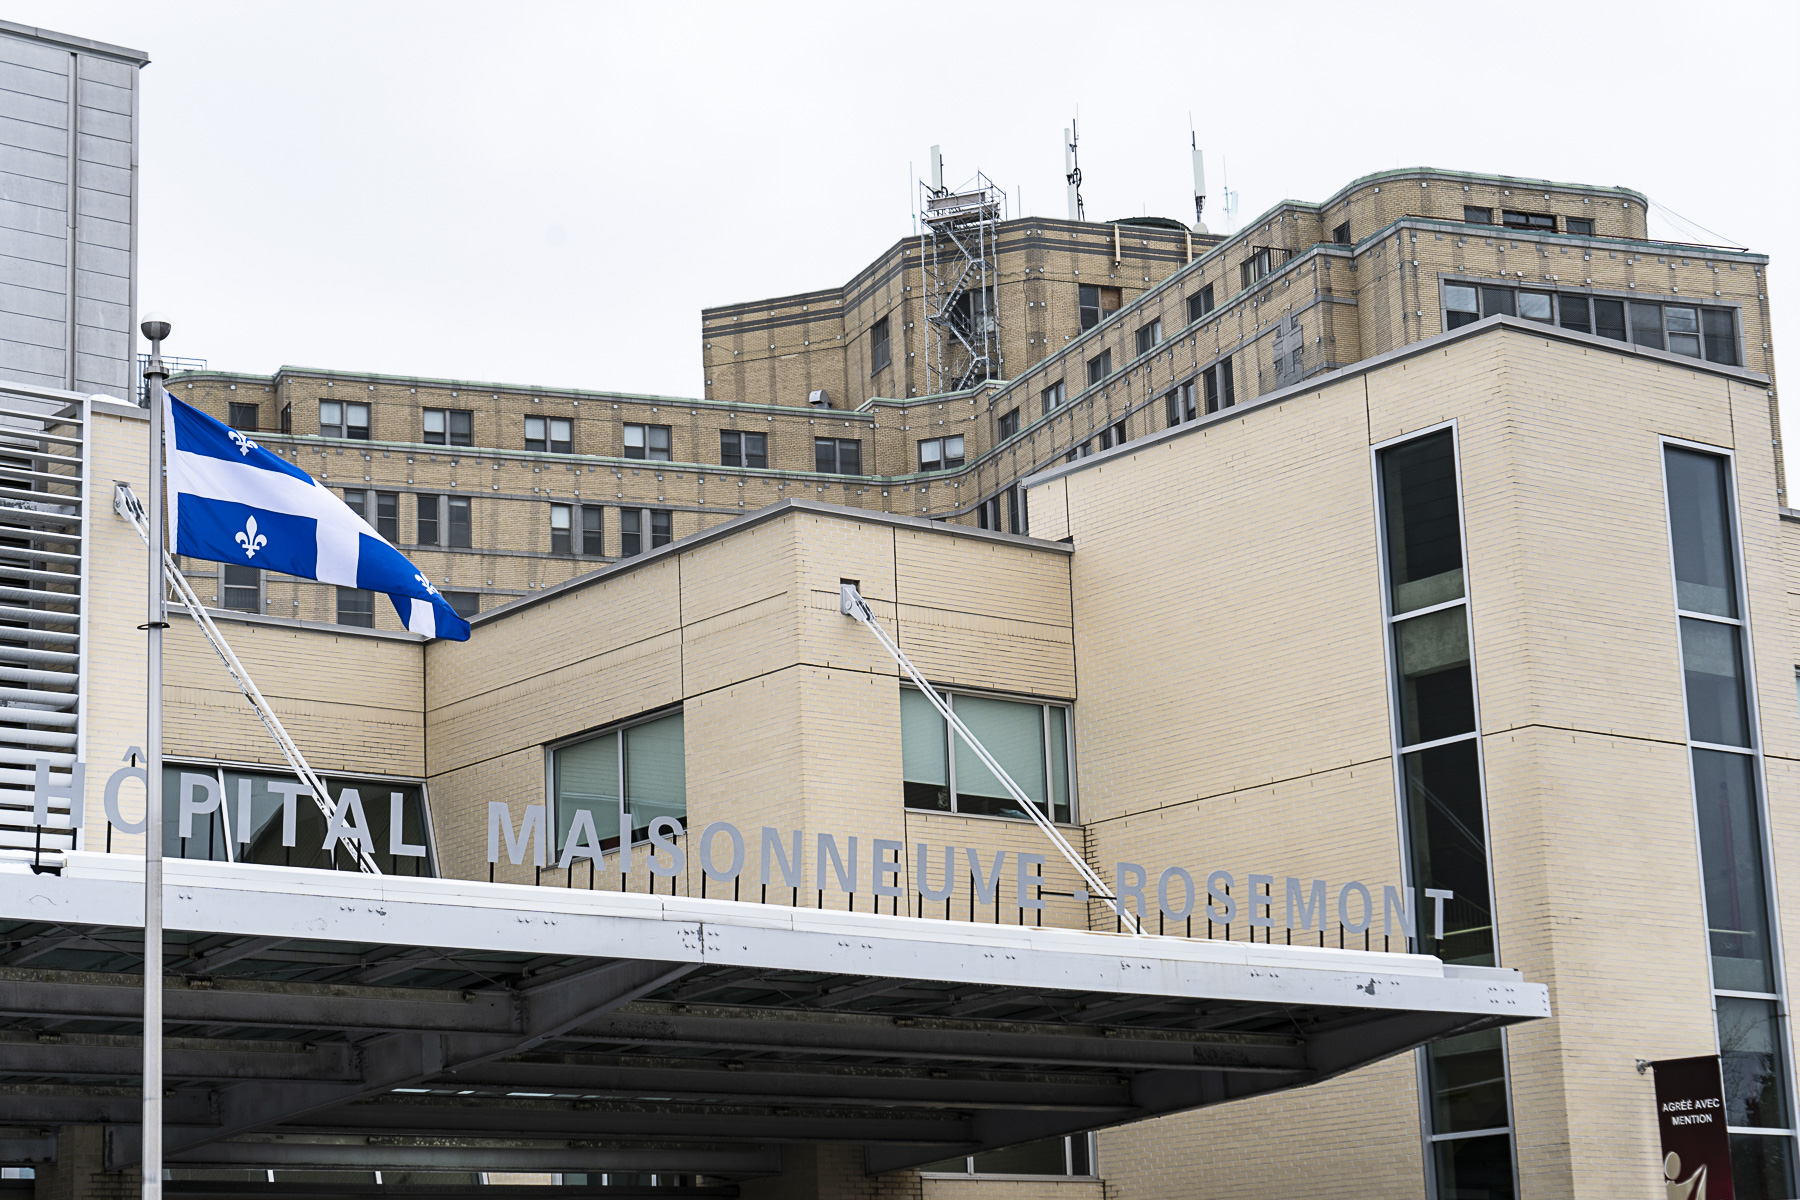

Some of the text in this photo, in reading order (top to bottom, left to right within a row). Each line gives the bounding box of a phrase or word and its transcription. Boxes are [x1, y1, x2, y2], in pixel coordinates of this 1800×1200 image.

[33, 746, 426, 858] HÔPITAL
[1662, 1098, 1720, 1112] AGRÉÉ AVEC
[1671, 1113, 1713, 1125] MENTION
